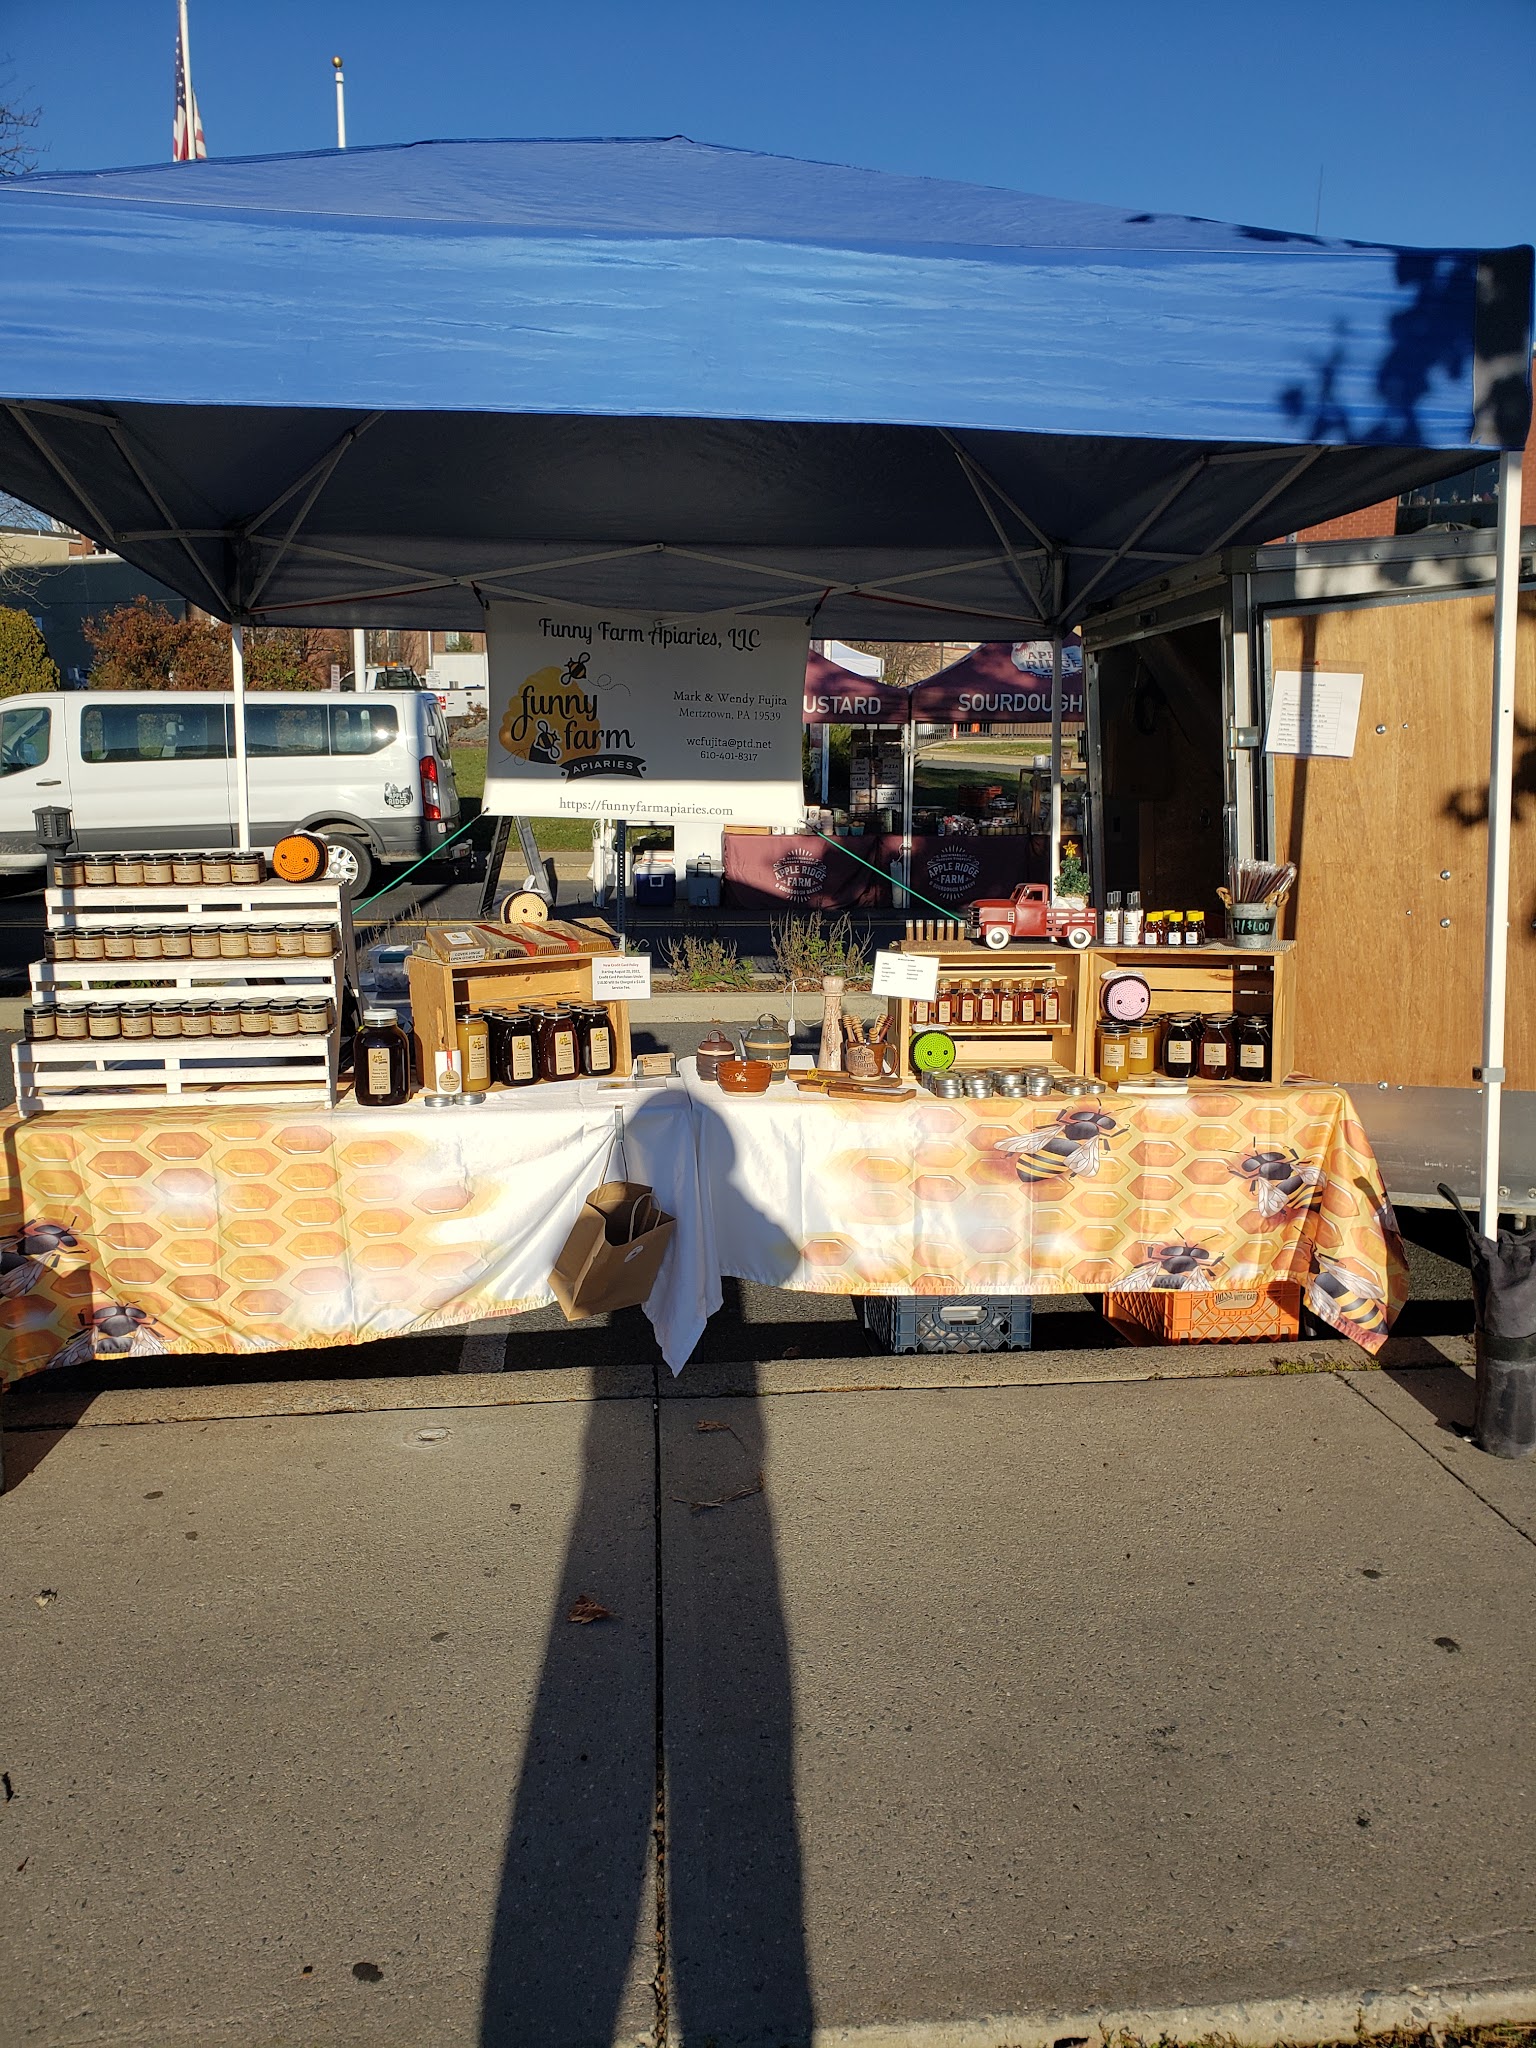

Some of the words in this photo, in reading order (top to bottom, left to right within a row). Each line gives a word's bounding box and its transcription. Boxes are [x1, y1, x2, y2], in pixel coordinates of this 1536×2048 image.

[539, 618, 592, 645] Funny
[598, 621, 645, 642] Farm
[648, 626, 722, 649] Apiaries,
[728, 628, 761, 652] LLC
[673, 690, 702, 702] Mark
[704, 693, 714, 702] &
[717, 693, 755, 706] Wendy
[758, 694, 788, 708] Fujita
[958, 693, 1083, 712] SOURDOUGH
[511, 685, 598, 741] funny
[679, 707, 734, 720] Mertztown,
[737, 710, 750, 720] PA
[754, 711, 781, 721] 19539
[564, 720, 636, 750] farm
[686, 736, 772, 750] wcfujita@ptd.net
[700, 750, 758, 761] 610-401-8317
[573, 760, 634, 774] APIARIES
[559, 797, 733, 816] https://funnyfarmapiaries.com
[774, 865, 800, 881] APPLE
[801, 865, 827, 882] RIDGE
[928, 862, 953, 878] APPLE
[954, 862, 980, 878] RIDGE
[787, 876, 812, 887] FARM
[940, 874, 965, 884] FARM
